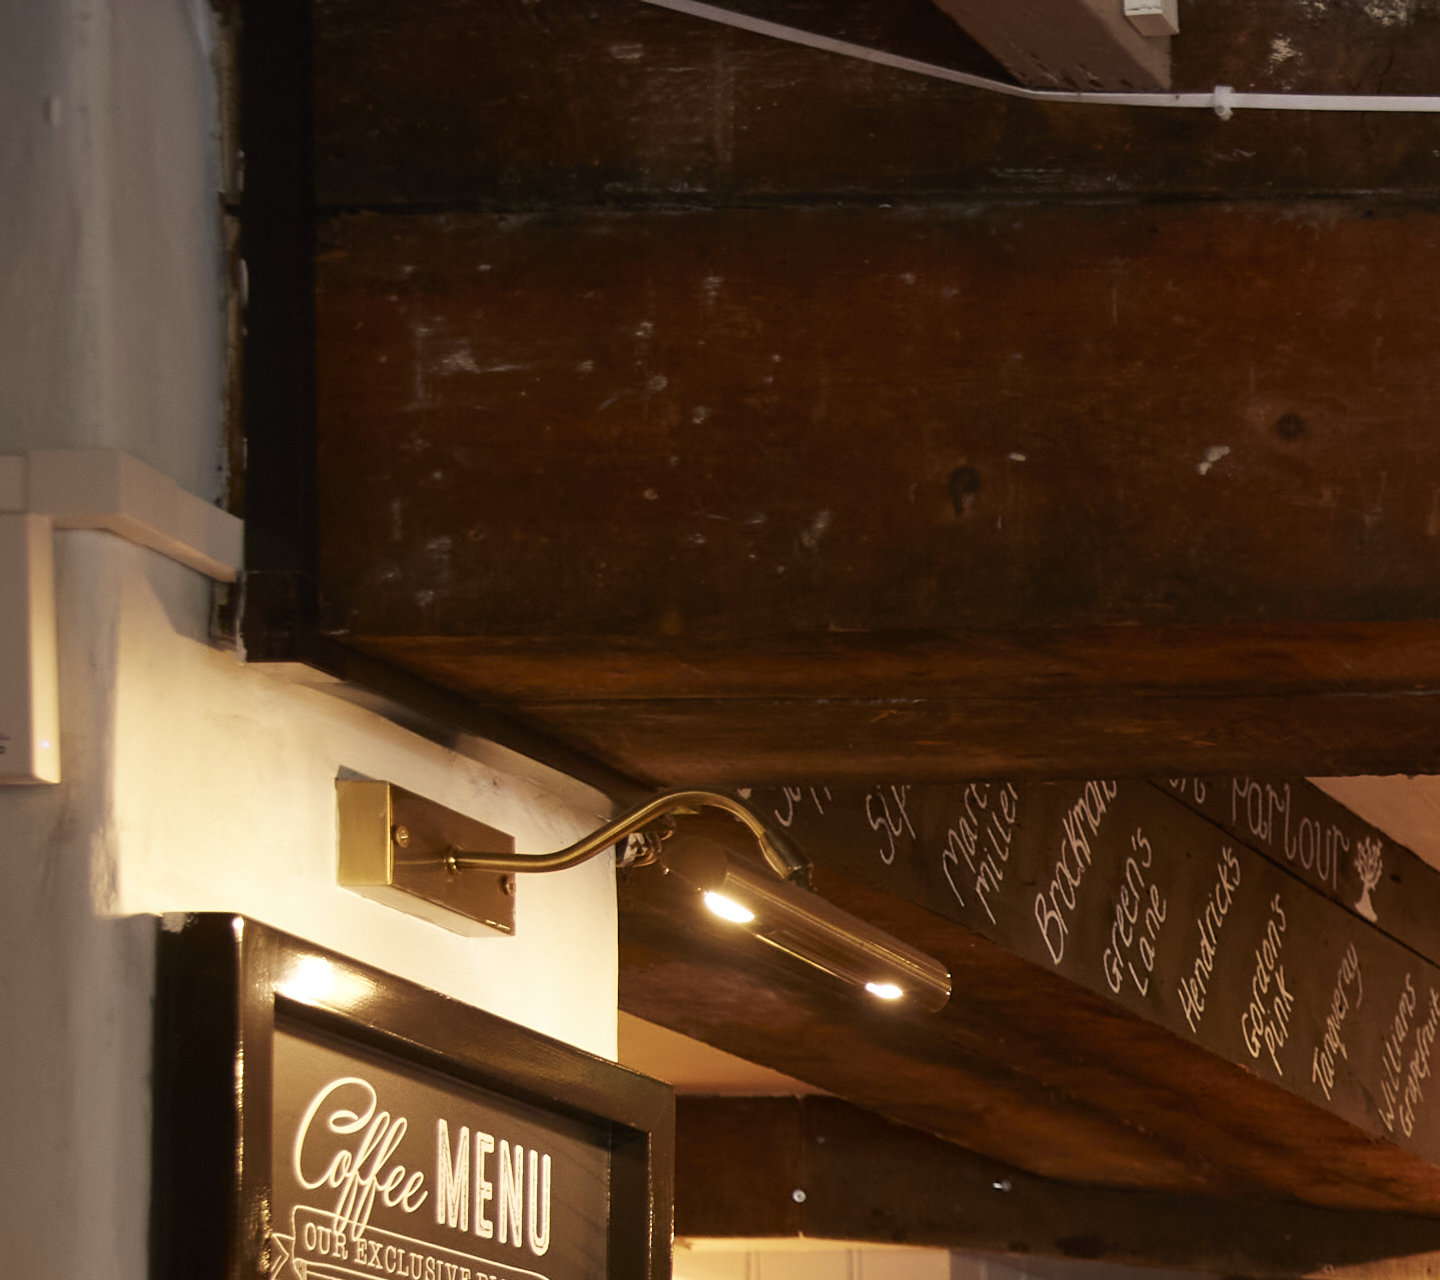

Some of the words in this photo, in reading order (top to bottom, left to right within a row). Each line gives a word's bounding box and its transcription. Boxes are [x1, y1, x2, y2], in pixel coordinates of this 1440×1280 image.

[1128, 884, 1168, 998] Lane
[1312, 943, 1364, 1101] Tanqueray
[293, 1077, 428, 1241] Coffee
[436, 1118, 551, 1256] MENU
[304, 1221, 348, 1260] OUR
